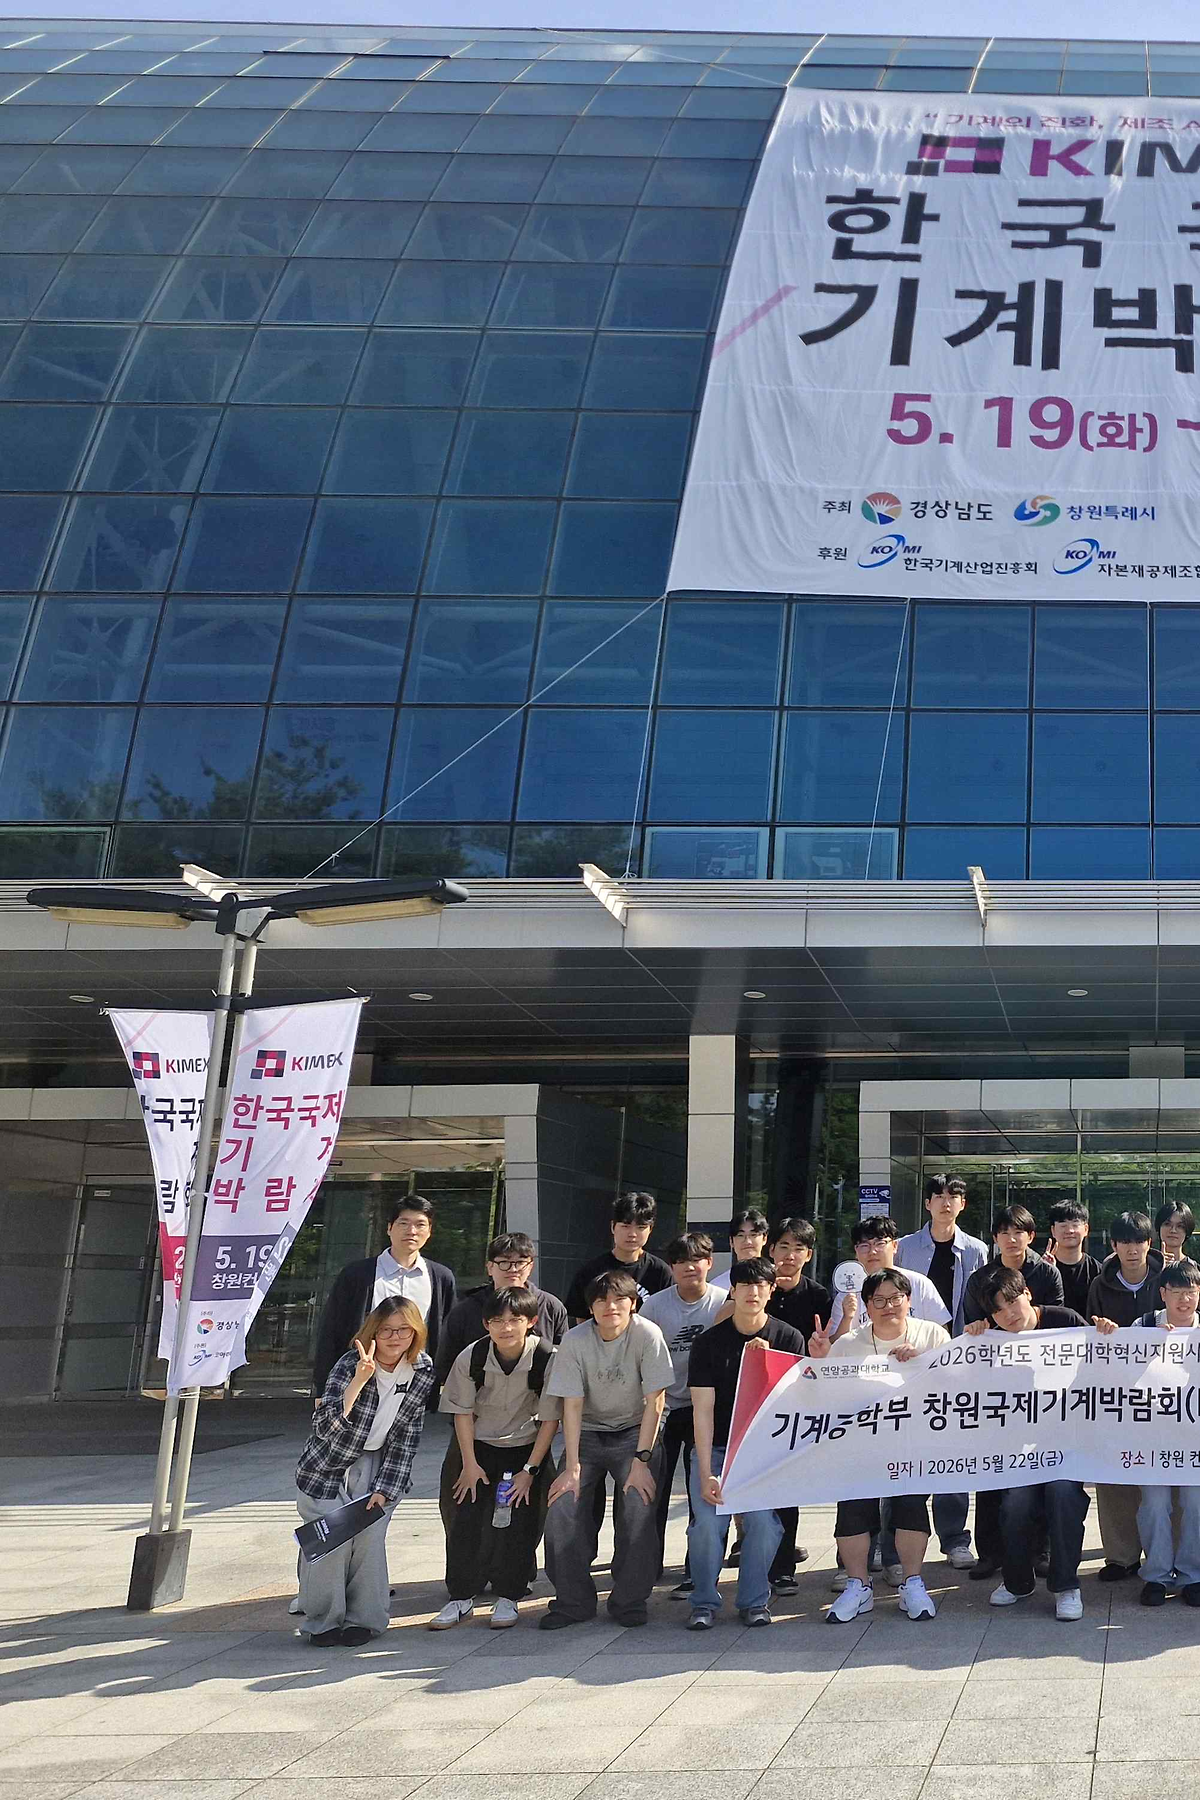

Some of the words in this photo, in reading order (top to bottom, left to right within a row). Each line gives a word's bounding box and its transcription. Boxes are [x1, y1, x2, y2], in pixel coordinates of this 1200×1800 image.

[1118, 115, 1173, 130] 제조
[822, 500, 852, 514] 주최
[910, 500, 994, 521] 경상남도
[1066, 505, 1156, 521] 창원특례시
[817, 547, 848, 561] 후원
[903, 556, 1038, 575] 한국기계산업진흥회
[291, 1051, 344, 1072] KIMEX
[929, 1344, 1032, 1370] 2026학년도
[820, 1364, 890, 1376] 연암공과대학교
[887, 1462, 914, 1480] 일자
[927, 1457, 978, 1476] 2026년
[982, 1456, 1004, 1473] 5월
[1008, 1450, 1065, 1470] 22일(금)
[1120, 1450, 1146, 1469] 장소
[1159, 1450, 1185, 1468] 창원
